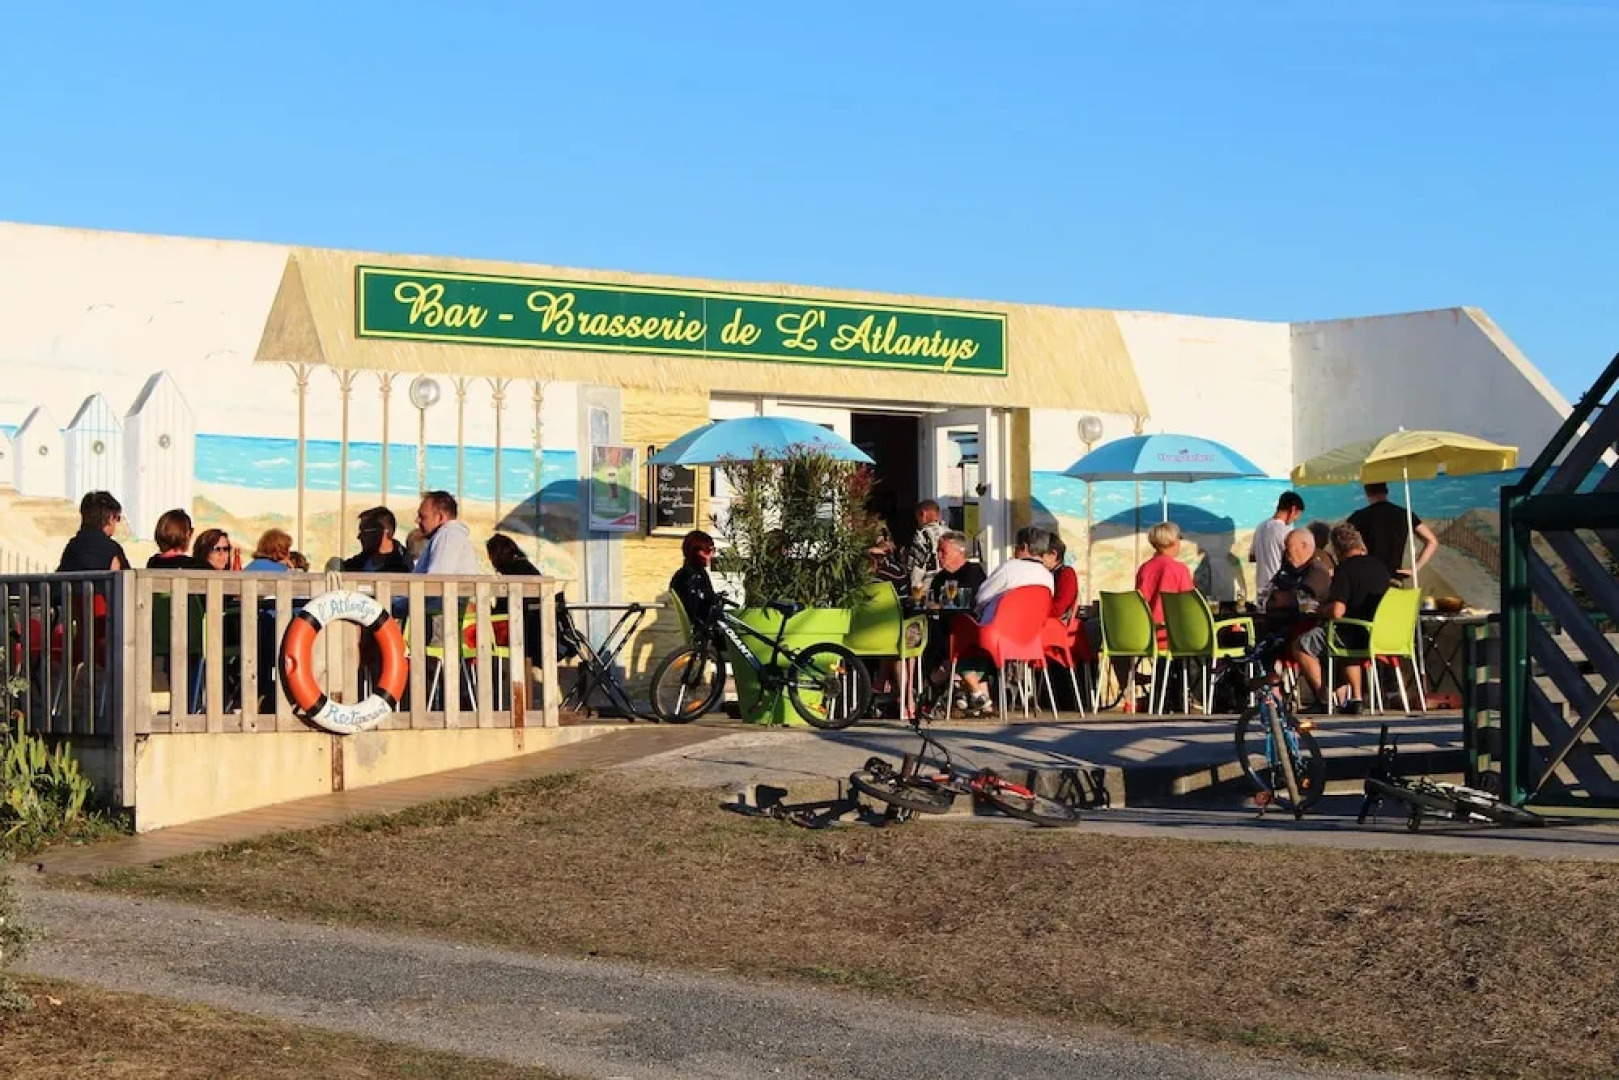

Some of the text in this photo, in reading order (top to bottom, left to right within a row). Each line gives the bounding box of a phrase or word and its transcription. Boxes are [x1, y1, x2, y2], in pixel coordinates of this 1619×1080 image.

[394, 281, 488, 329] Bar
[527, 290, 707, 342] Brasserie
[721, 307, 761, 346] de
